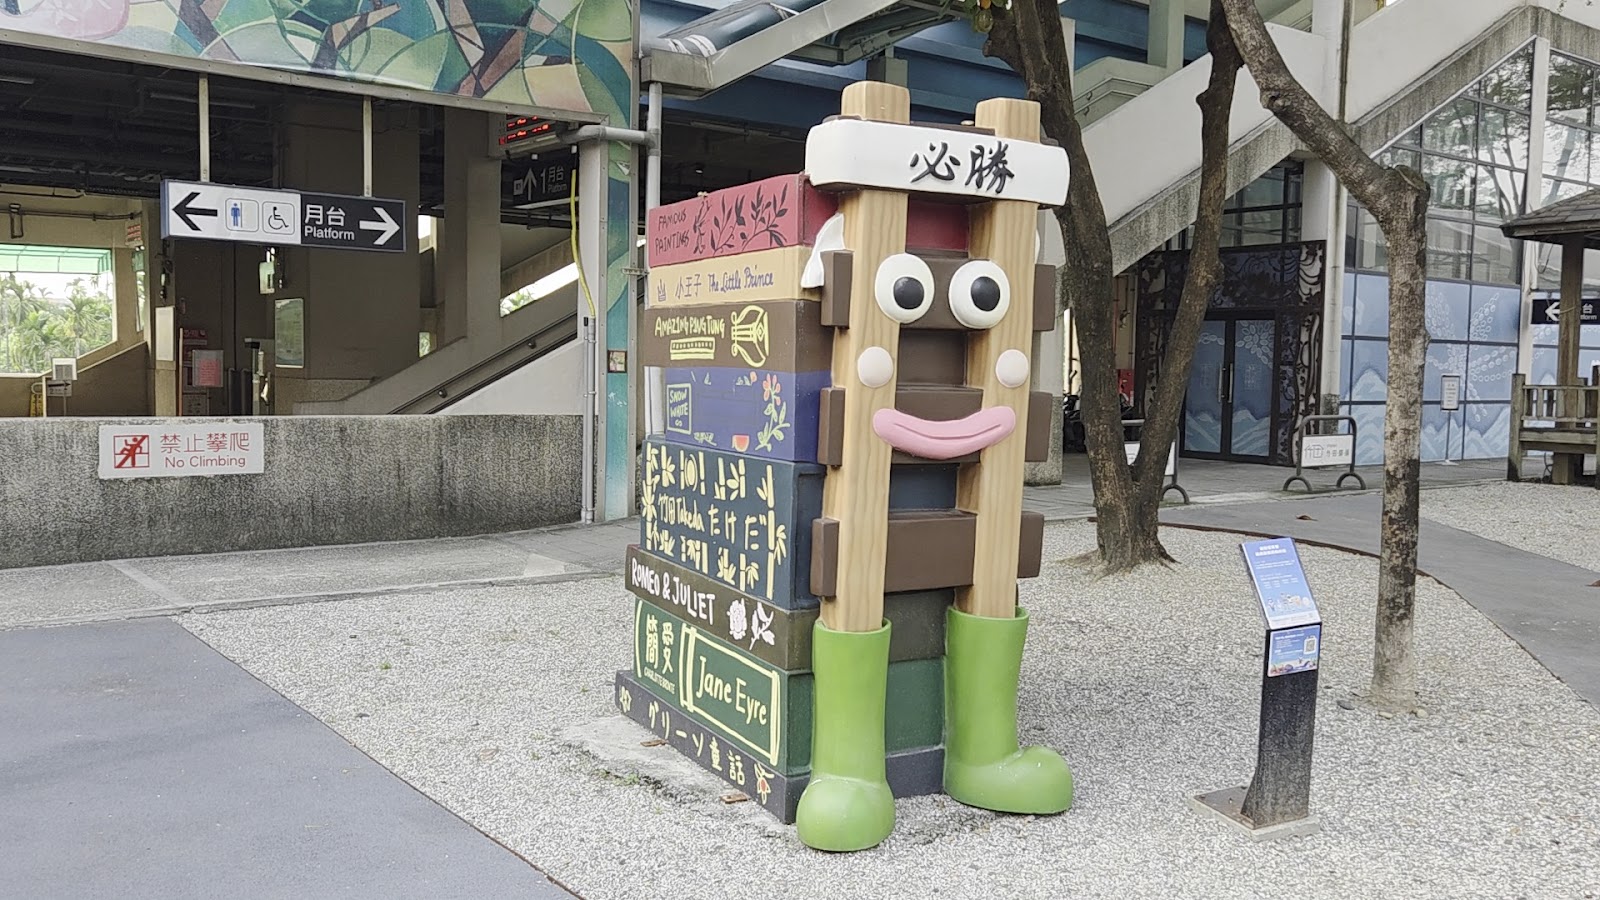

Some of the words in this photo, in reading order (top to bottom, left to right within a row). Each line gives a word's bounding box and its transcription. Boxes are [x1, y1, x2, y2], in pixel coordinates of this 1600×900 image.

[540, 168, 546, 194] 1
[548, 166, 564, 182] 月台
[910, 141, 1015, 194] 必勝
[304, 204, 346, 226] 月台
[658, 208, 687, 231] FAMOUS
[304, 225, 355, 240] Platform
[655, 229, 690, 256] PAINTINGS
[675, 273, 701, 299] 小王子
[708, 273, 719, 292] The
[720, 270, 741, 293] Little
[744, 264, 773, 289] Prince
[670, 388, 688, 404] SNOW
[670, 402, 688, 418] WHITE
[160, 432, 250, 454] 禁止攀爬
[165, 456, 185, 469] No
[189, 455, 246, 469] Climbing
[708, 503, 767, 551] たけだ
[631, 557, 660, 596] ROMEO
[662, 572, 671, 600] &
[672, 576, 716, 625] JULIET
[696, 655, 732, 704] Jane
[735, 677, 767, 725] Eyre
